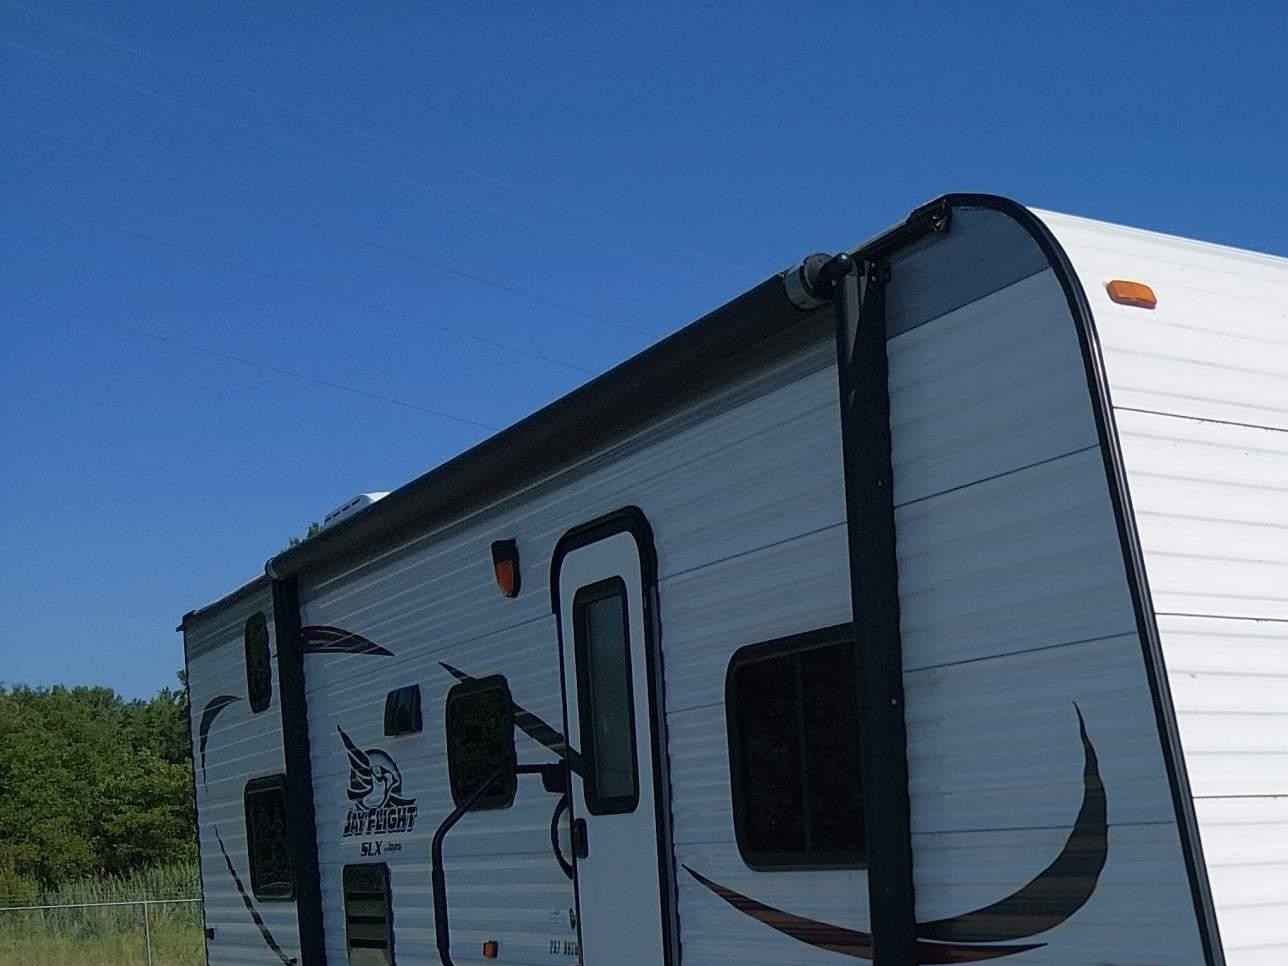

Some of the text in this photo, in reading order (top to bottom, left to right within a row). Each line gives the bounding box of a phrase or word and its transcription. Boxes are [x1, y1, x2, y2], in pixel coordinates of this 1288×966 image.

[343, 807, 418, 837] JAY FLIGHT
[360, 841, 383, 857] SLX
